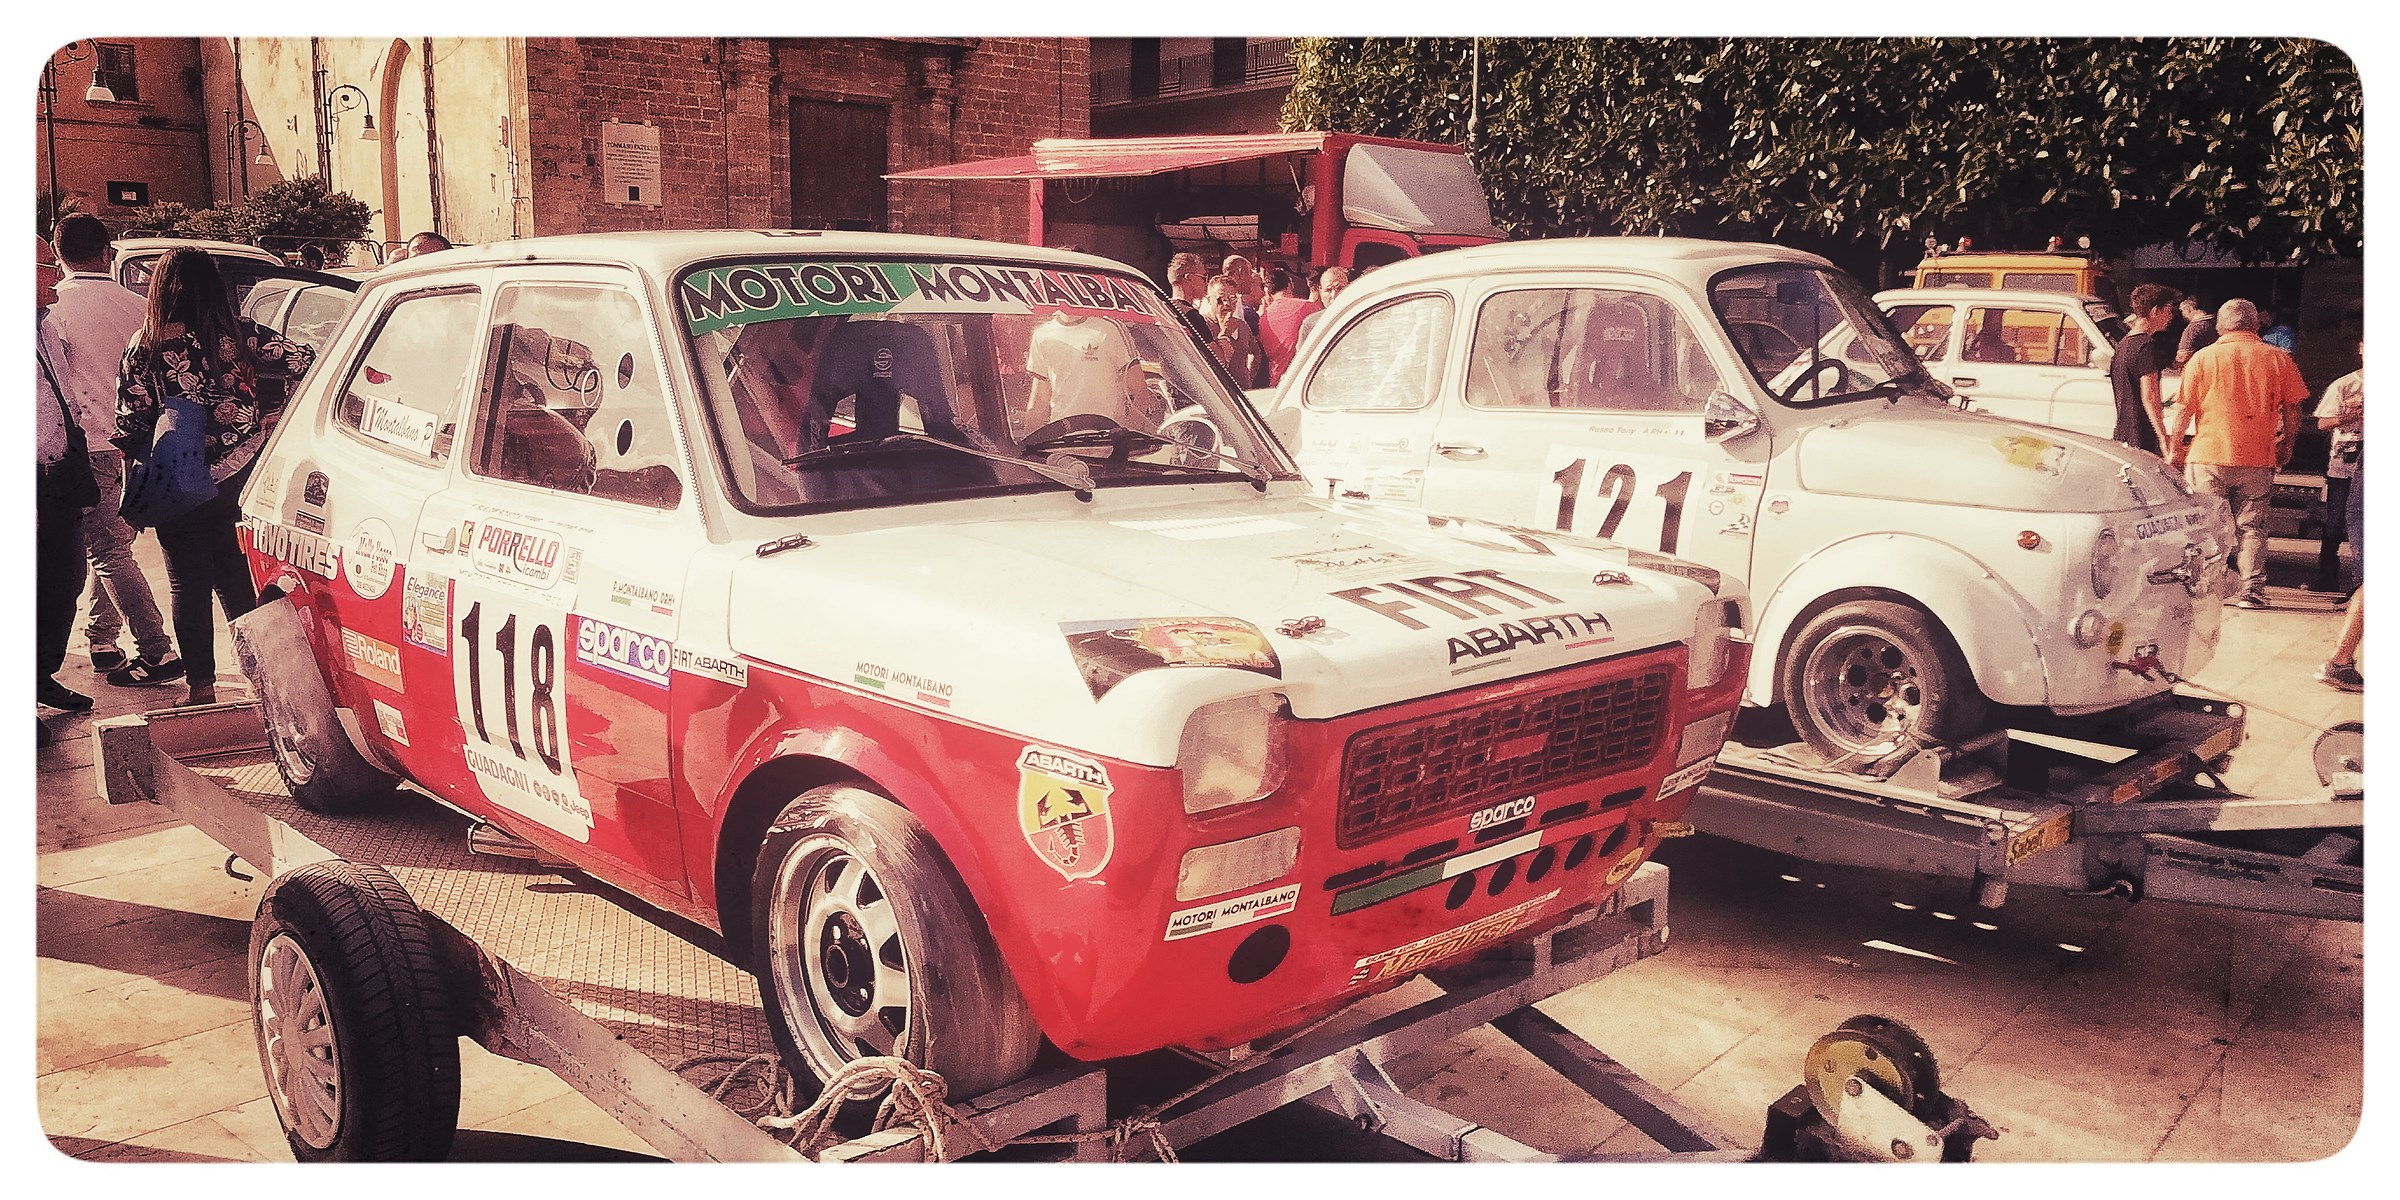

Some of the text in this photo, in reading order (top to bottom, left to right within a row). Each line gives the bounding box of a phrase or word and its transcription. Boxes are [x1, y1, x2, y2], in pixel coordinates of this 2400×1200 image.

[681, 264, 898, 322] MOTORI
[1552, 458, 1693, 556] 121
[478, 524, 560, 570] PORRELLO
[407, 576, 445, 600] Elegance
[1327, 569, 1566, 631] FIAT
[357, 636, 401, 676] Roland
[579, 617, 671, 675] sparco
[1448, 610, 1613, 667] ABARTH
[673, 648, 745, 679] FIAT ABARTH
[856, 661, 953, 697] MOTORI MONTALBANO
[461, 601, 562, 776] 118
[467, 748, 590, 820] GUADAGNI Jeep
[1026, 752, 1103, 784] ABARTH
[1470, 795, 1536, 830] sparco
[1171, 889, 1296, 928] MOTORI MONTALBANO
